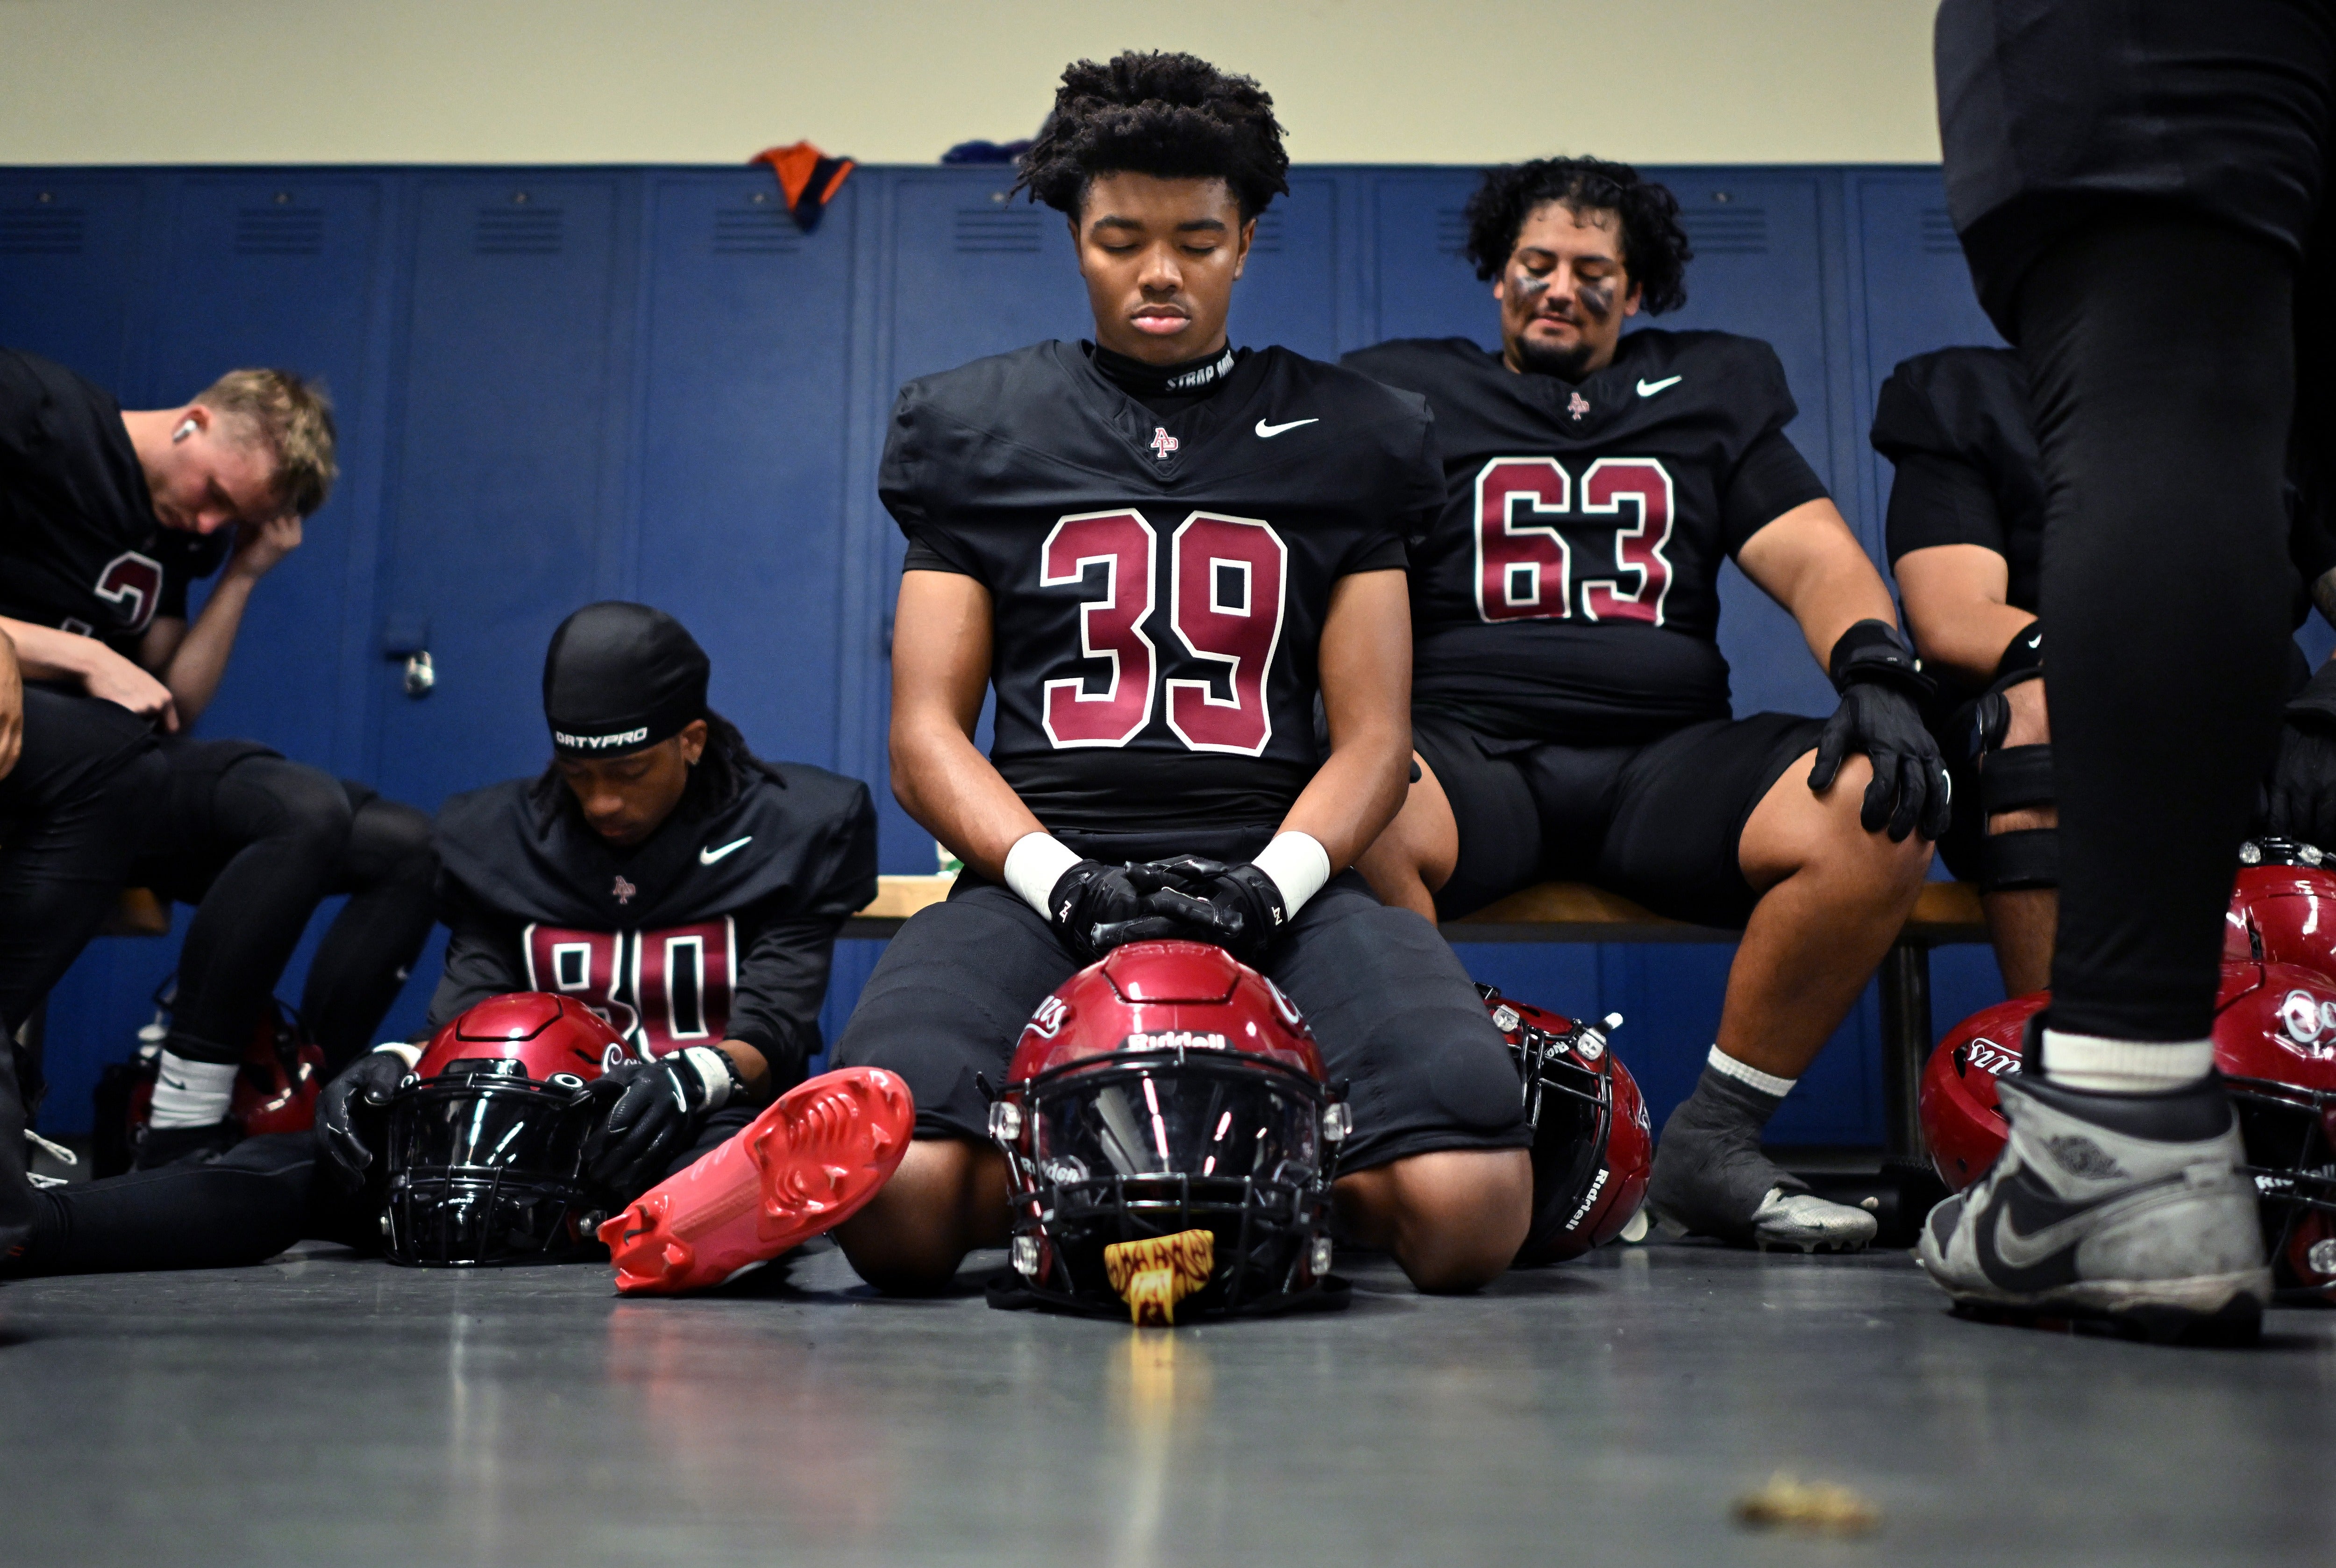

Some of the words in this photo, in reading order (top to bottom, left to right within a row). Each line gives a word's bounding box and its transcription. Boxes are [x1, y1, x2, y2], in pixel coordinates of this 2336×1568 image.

[1166, 365, 1214, 391] STRAP
[1150, 427, 1178, 458] AP
[1475, 457, 1674, 626] 63
[1040, 508, 1287, 757] 39
[556, 727, 648, 748] DRTYPRO
[522, 915, 737, 1063] 80
[1129, 1031, 1225, 1050] Riddell
[1565, 1169, 1609, 1230] Riddell
